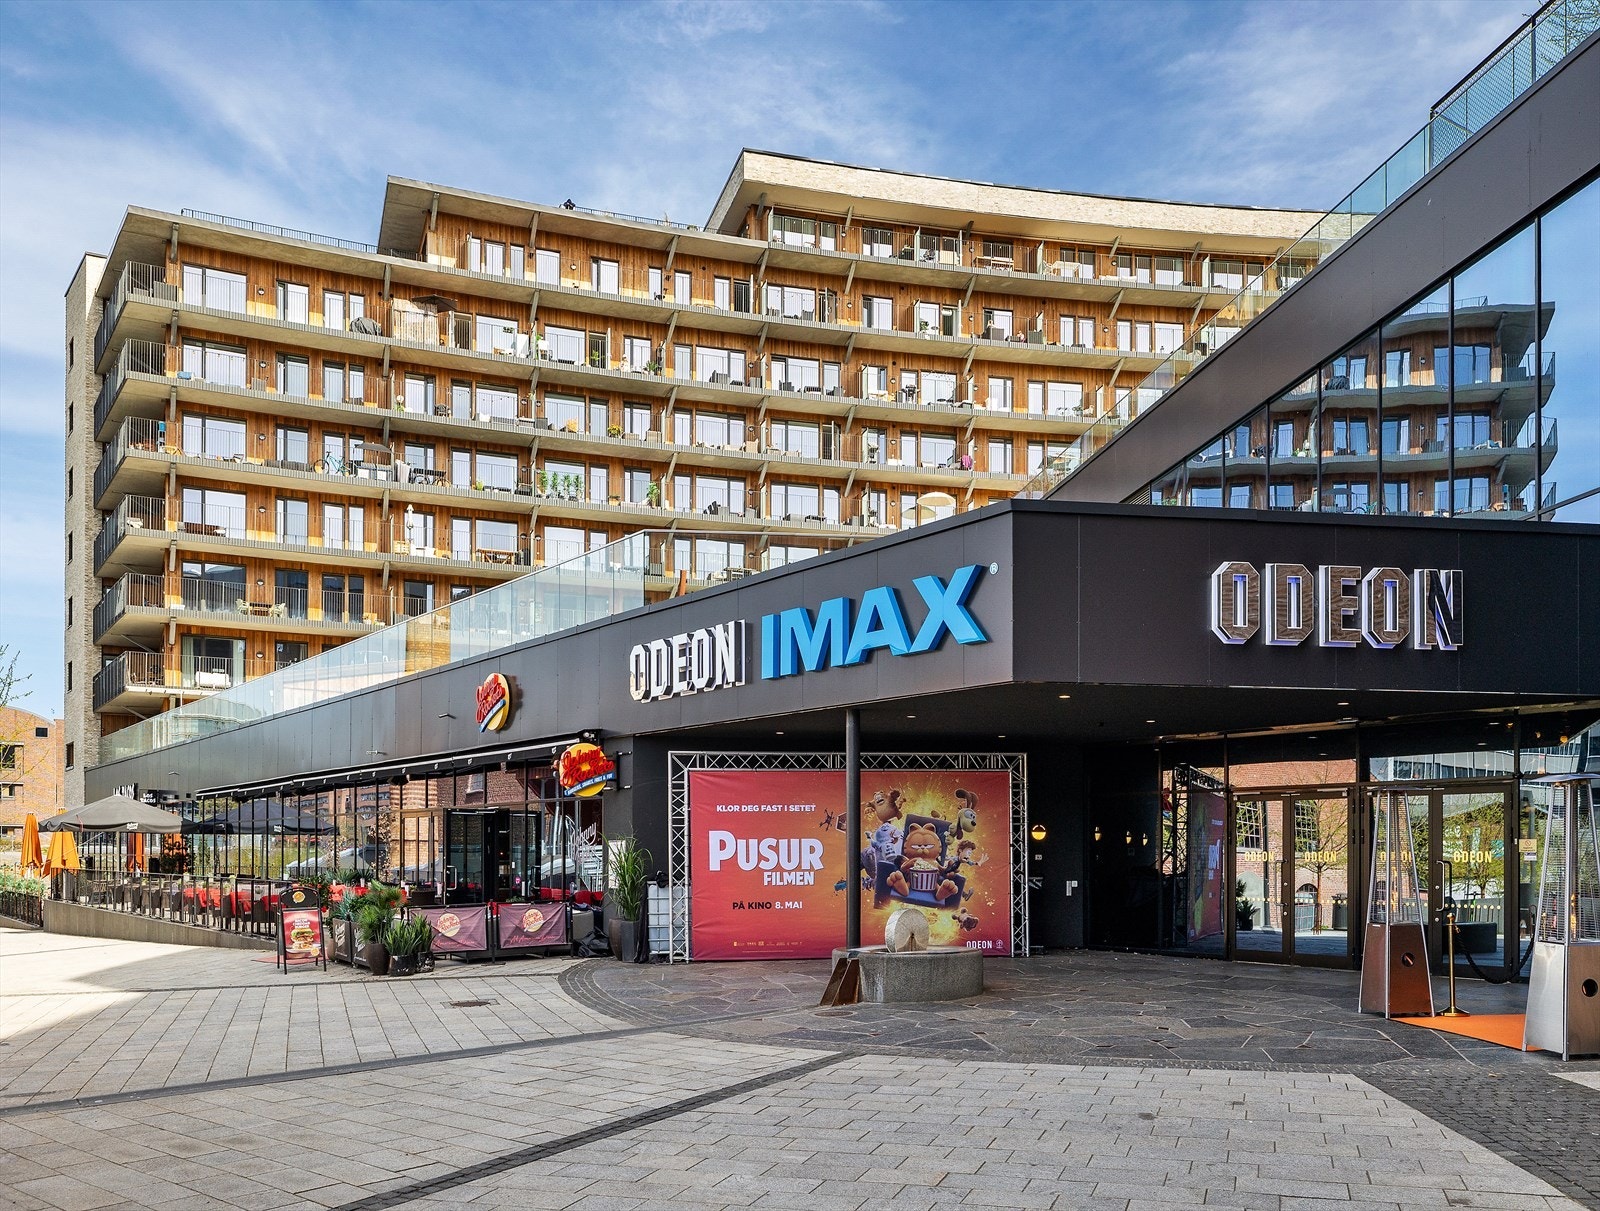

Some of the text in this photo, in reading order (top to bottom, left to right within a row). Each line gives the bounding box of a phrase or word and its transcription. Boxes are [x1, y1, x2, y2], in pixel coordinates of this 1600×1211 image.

[1211, 561, 1464, 650] ODEON
[629, 564, 988, 703] ODEON IMAX
[716, 804, 816, 813] KLOR DEG FAST I SETET
[708, 830, 824, 872] PUSUR
[1244, 851, 1275, 862] ODEON
[1304, 851, 1337, 863] ODEON
[1453, 851, 1492, 863] ODEON
[763, 871, 815, 886] FILMEN
[732, 901, 803, 910] PÅ KINO 8. MAI
[966, 940, 993, 949] ODEON
